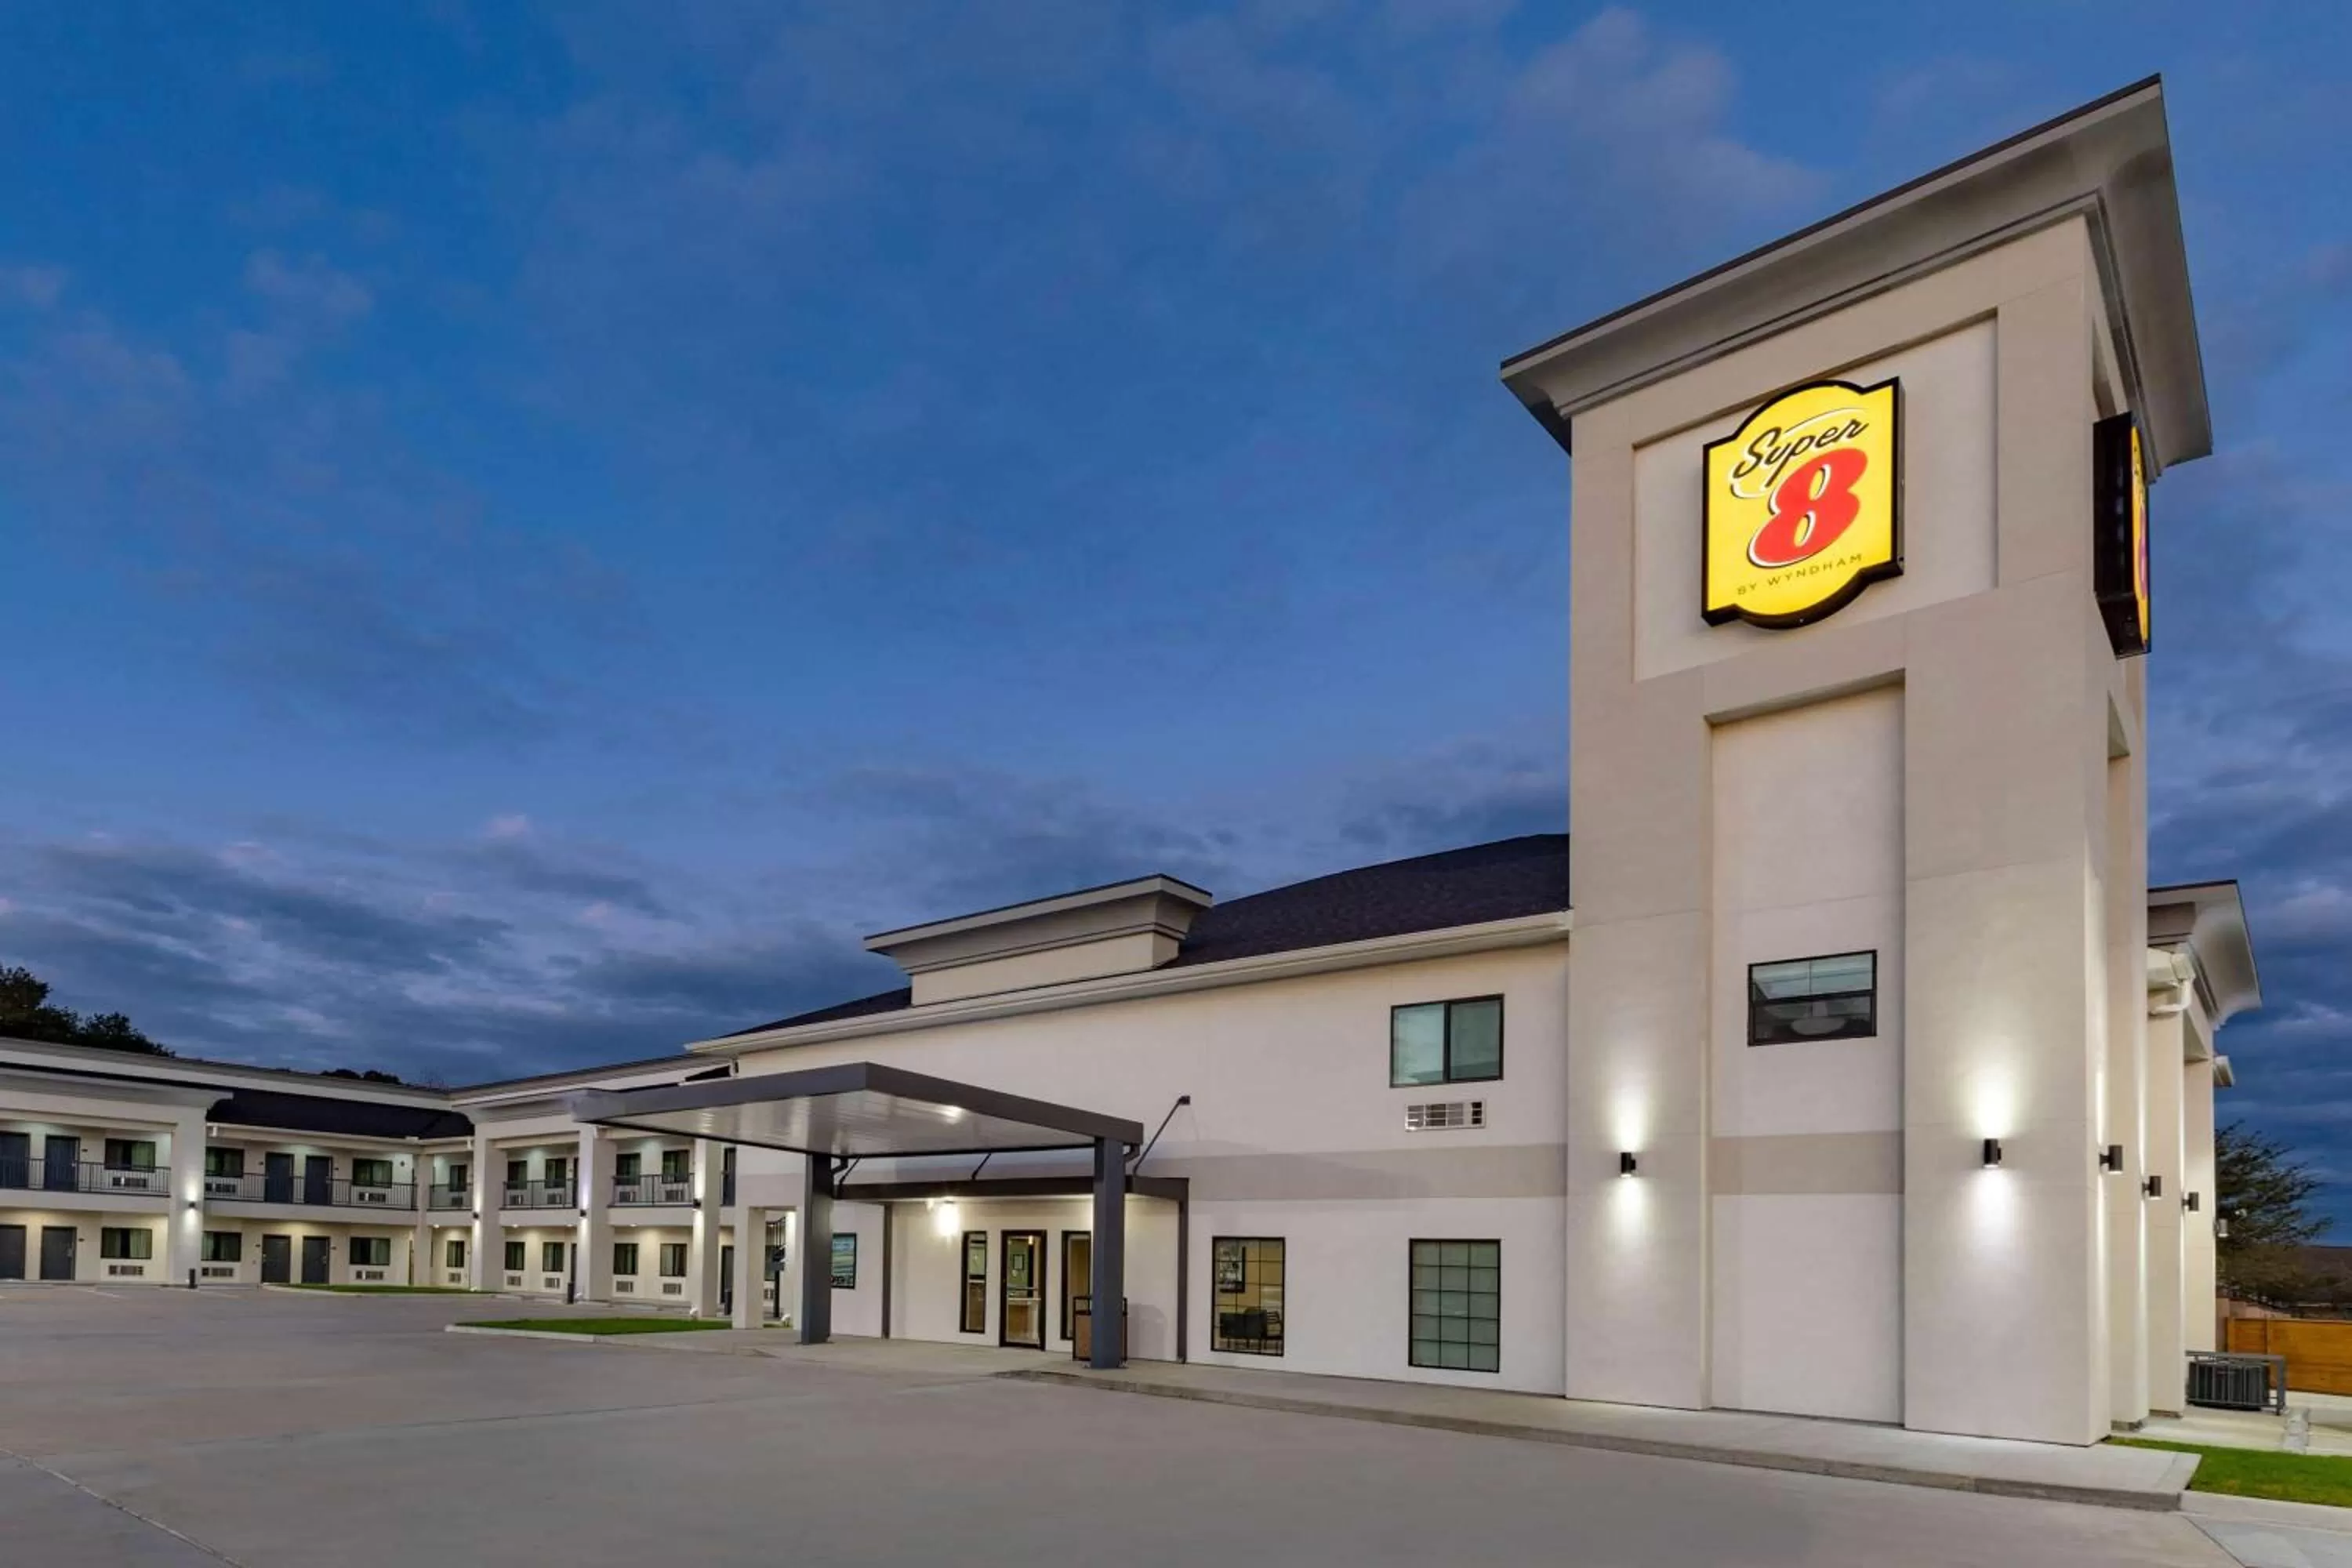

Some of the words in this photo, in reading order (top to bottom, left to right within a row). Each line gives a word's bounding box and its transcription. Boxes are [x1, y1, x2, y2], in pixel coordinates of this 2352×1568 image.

[1731, 416, 1870, 488] Super
[1746, 448, 1869, 569] 8
[1737, 583, 1758, 597] BY
[1767, 553, 1863, 587] WYNDHAM
